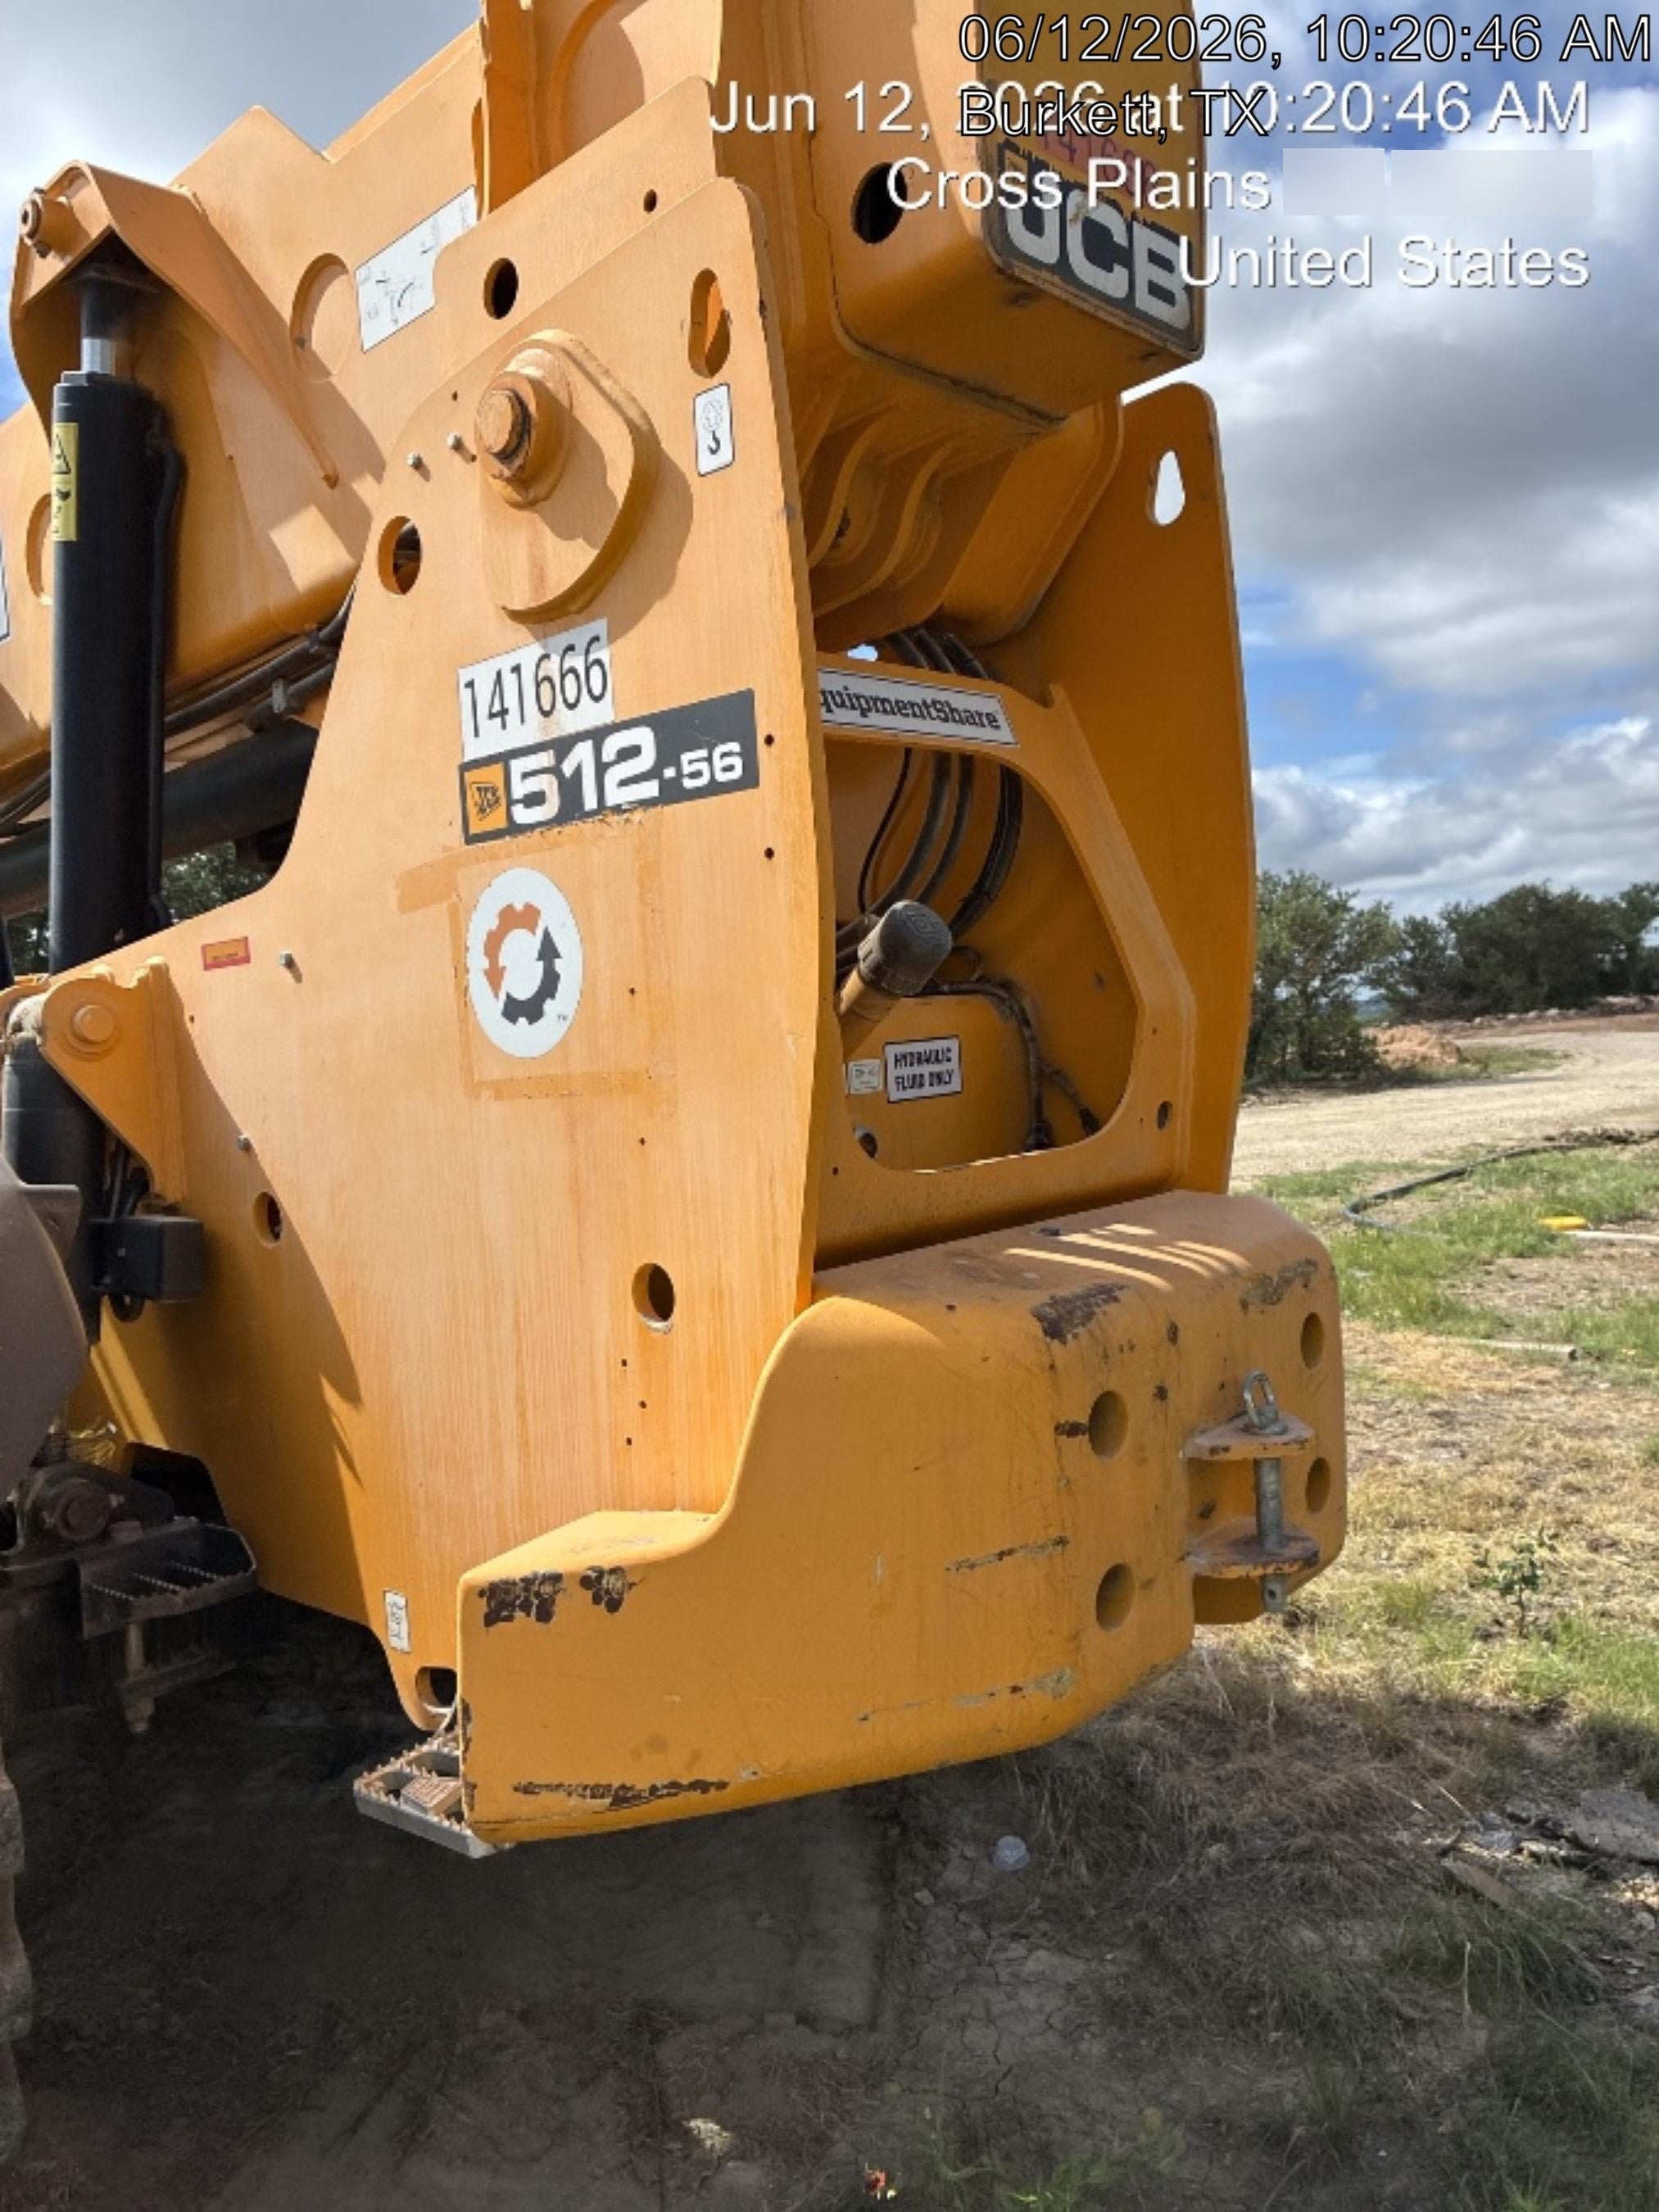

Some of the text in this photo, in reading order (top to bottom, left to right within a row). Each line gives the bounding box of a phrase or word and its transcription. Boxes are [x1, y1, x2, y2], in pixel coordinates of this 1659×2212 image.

[1004, 170, 1190, 330] JCB
[464, 634, 608, 738] 141666
[820, 684, 1002, 730] quipmentShare
[894, 1046, 952, 1069] HYDRAULIC
[895, 1072, 925, 1092] FLUID
[928, 1068, 954, 1087] ONLY
